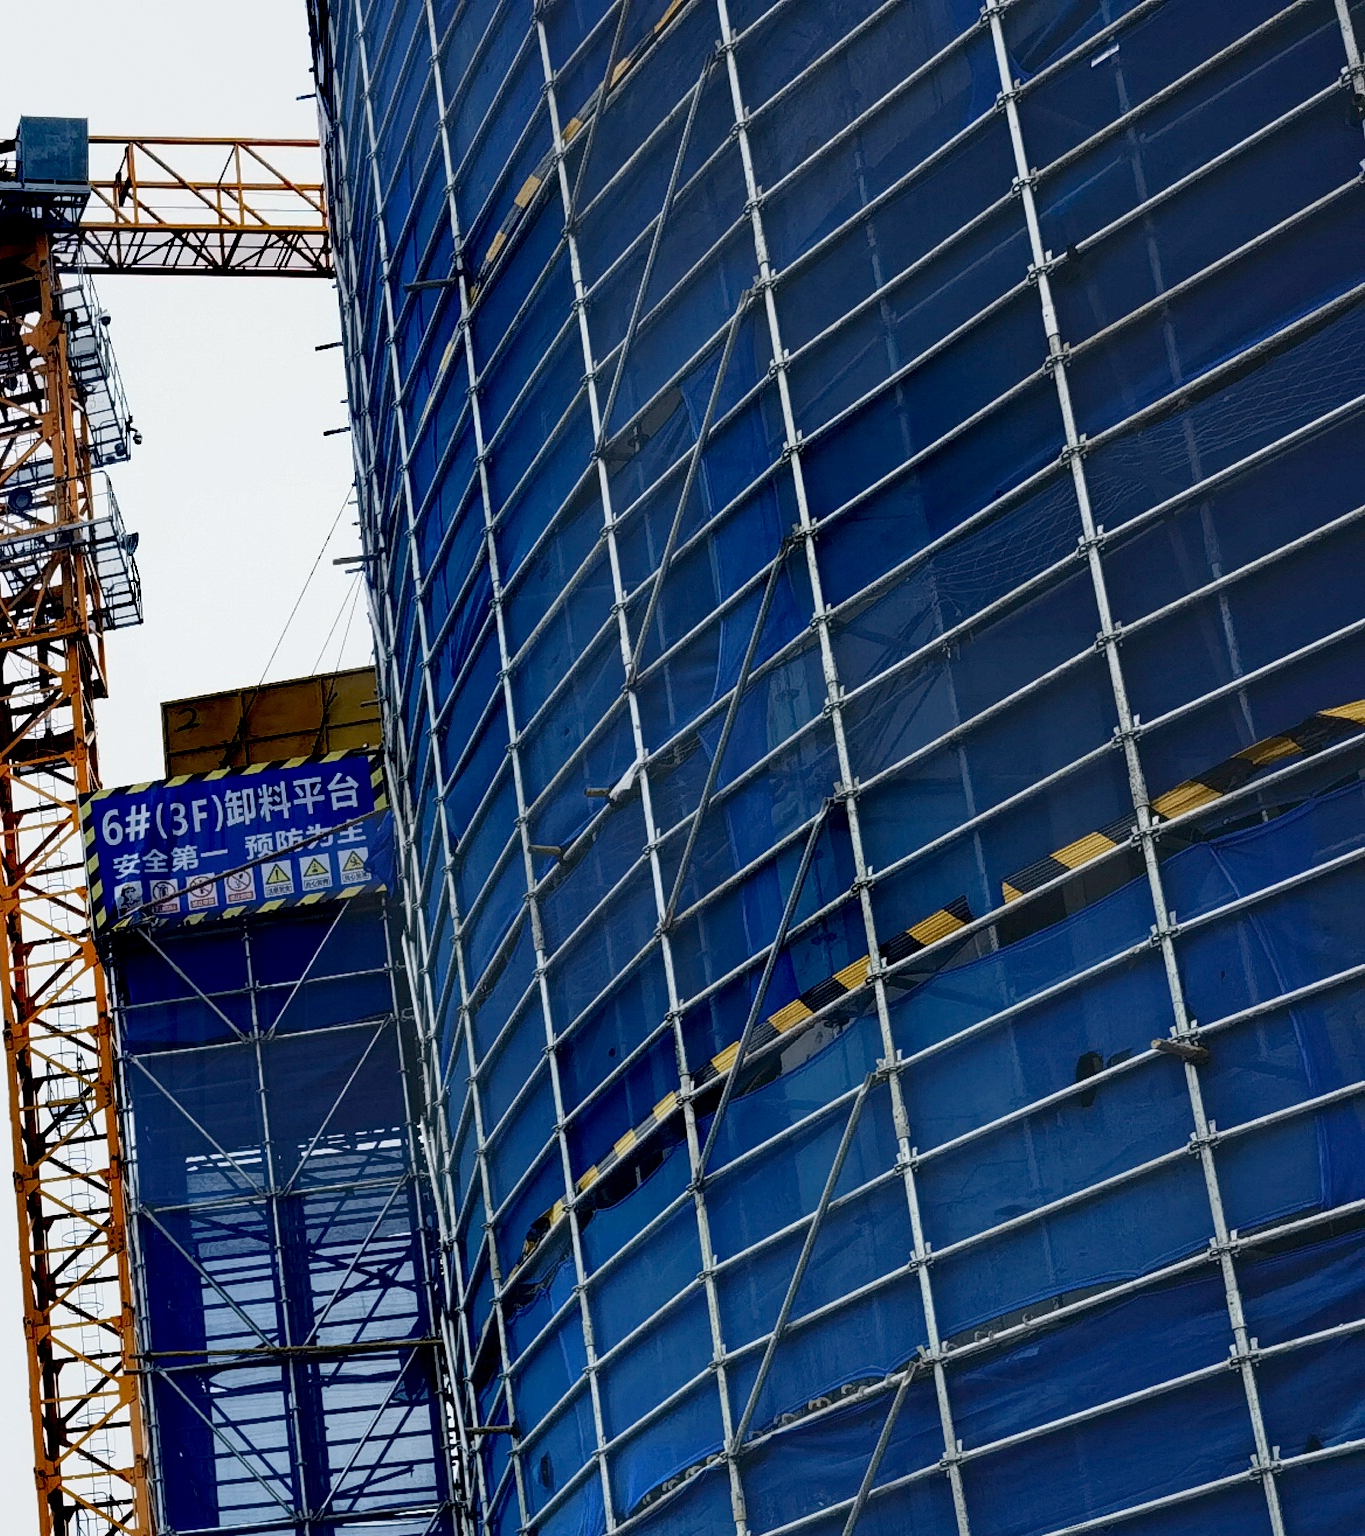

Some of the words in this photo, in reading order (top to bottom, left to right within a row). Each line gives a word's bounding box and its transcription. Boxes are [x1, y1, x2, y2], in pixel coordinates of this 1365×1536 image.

[102, 772, 359, 845] 6#(3F)卸料平台
[113, 845, 228, 879] 安全第一
[245, 818, 367, 861] 预防为主
